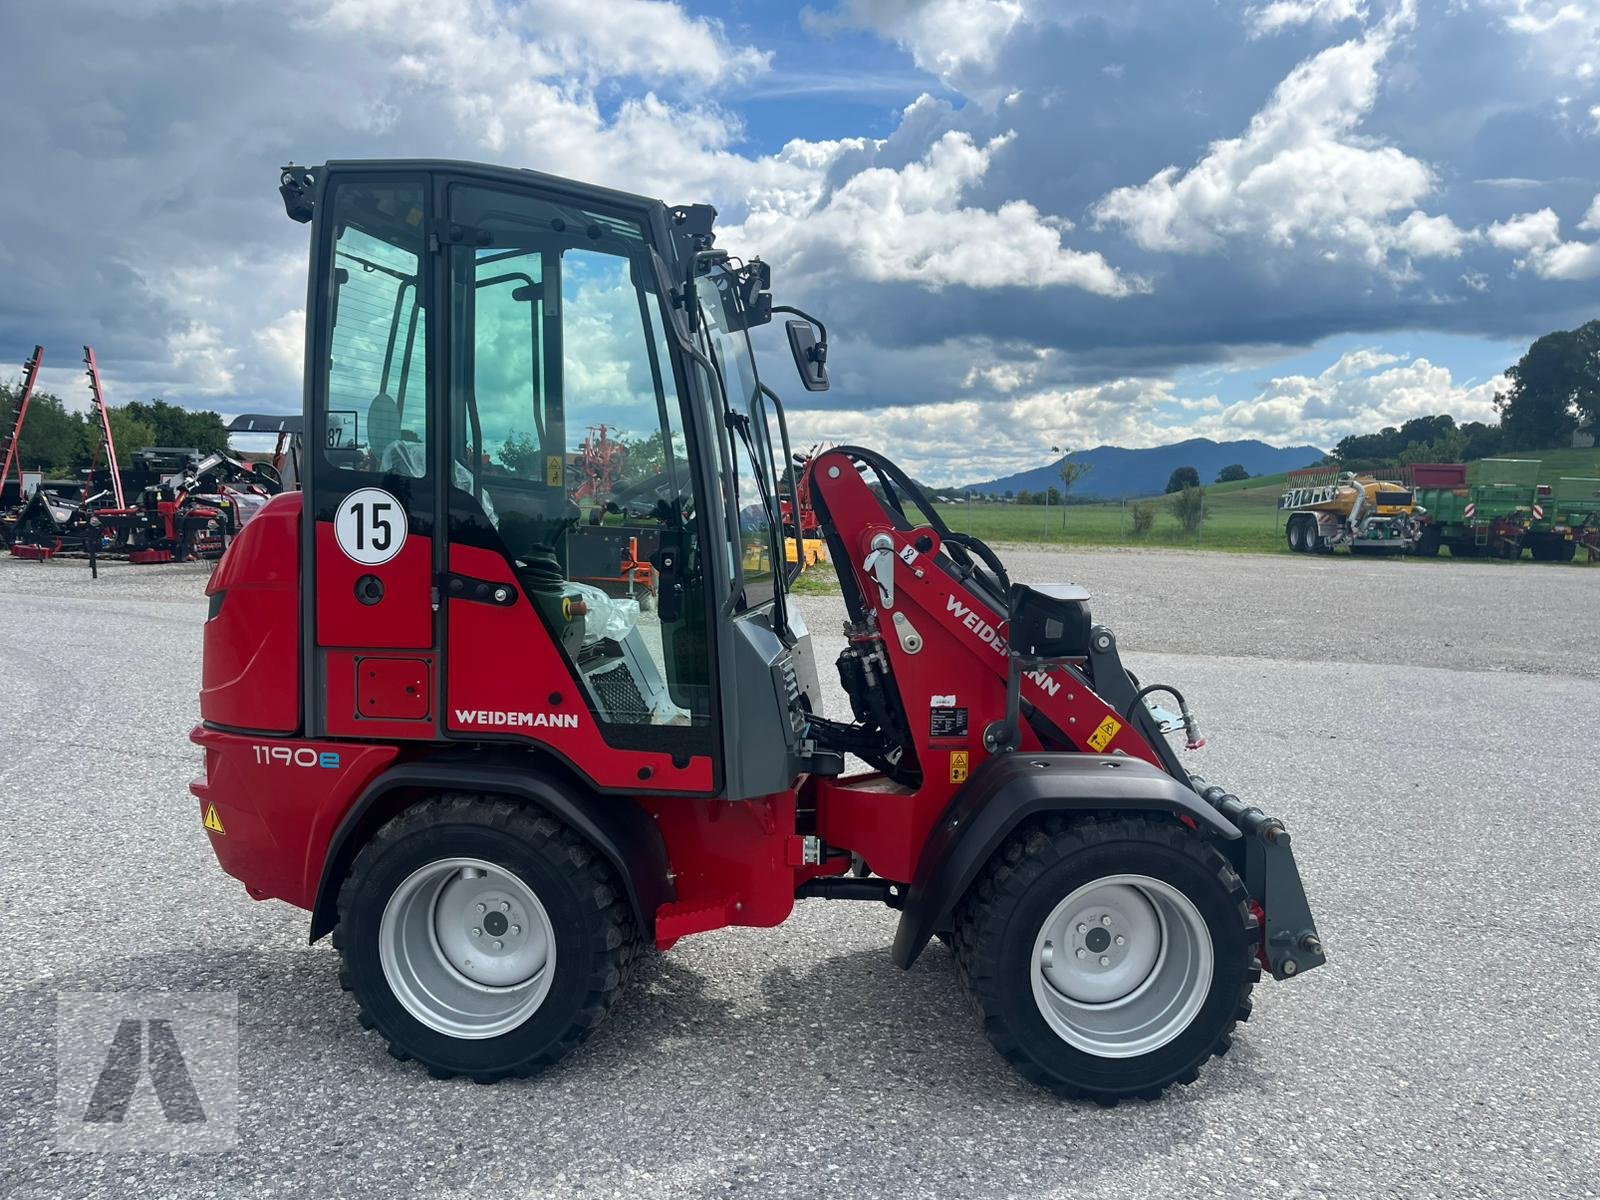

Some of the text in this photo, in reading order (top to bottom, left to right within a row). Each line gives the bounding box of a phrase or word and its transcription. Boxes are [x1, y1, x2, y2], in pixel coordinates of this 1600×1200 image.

[327, 428, 343, 448] 87
[350, 502, 392, 551] 15
[946, 593, 1061, 697] WEIDENN
[455, 709, 578, 729] WEIDEMANN
